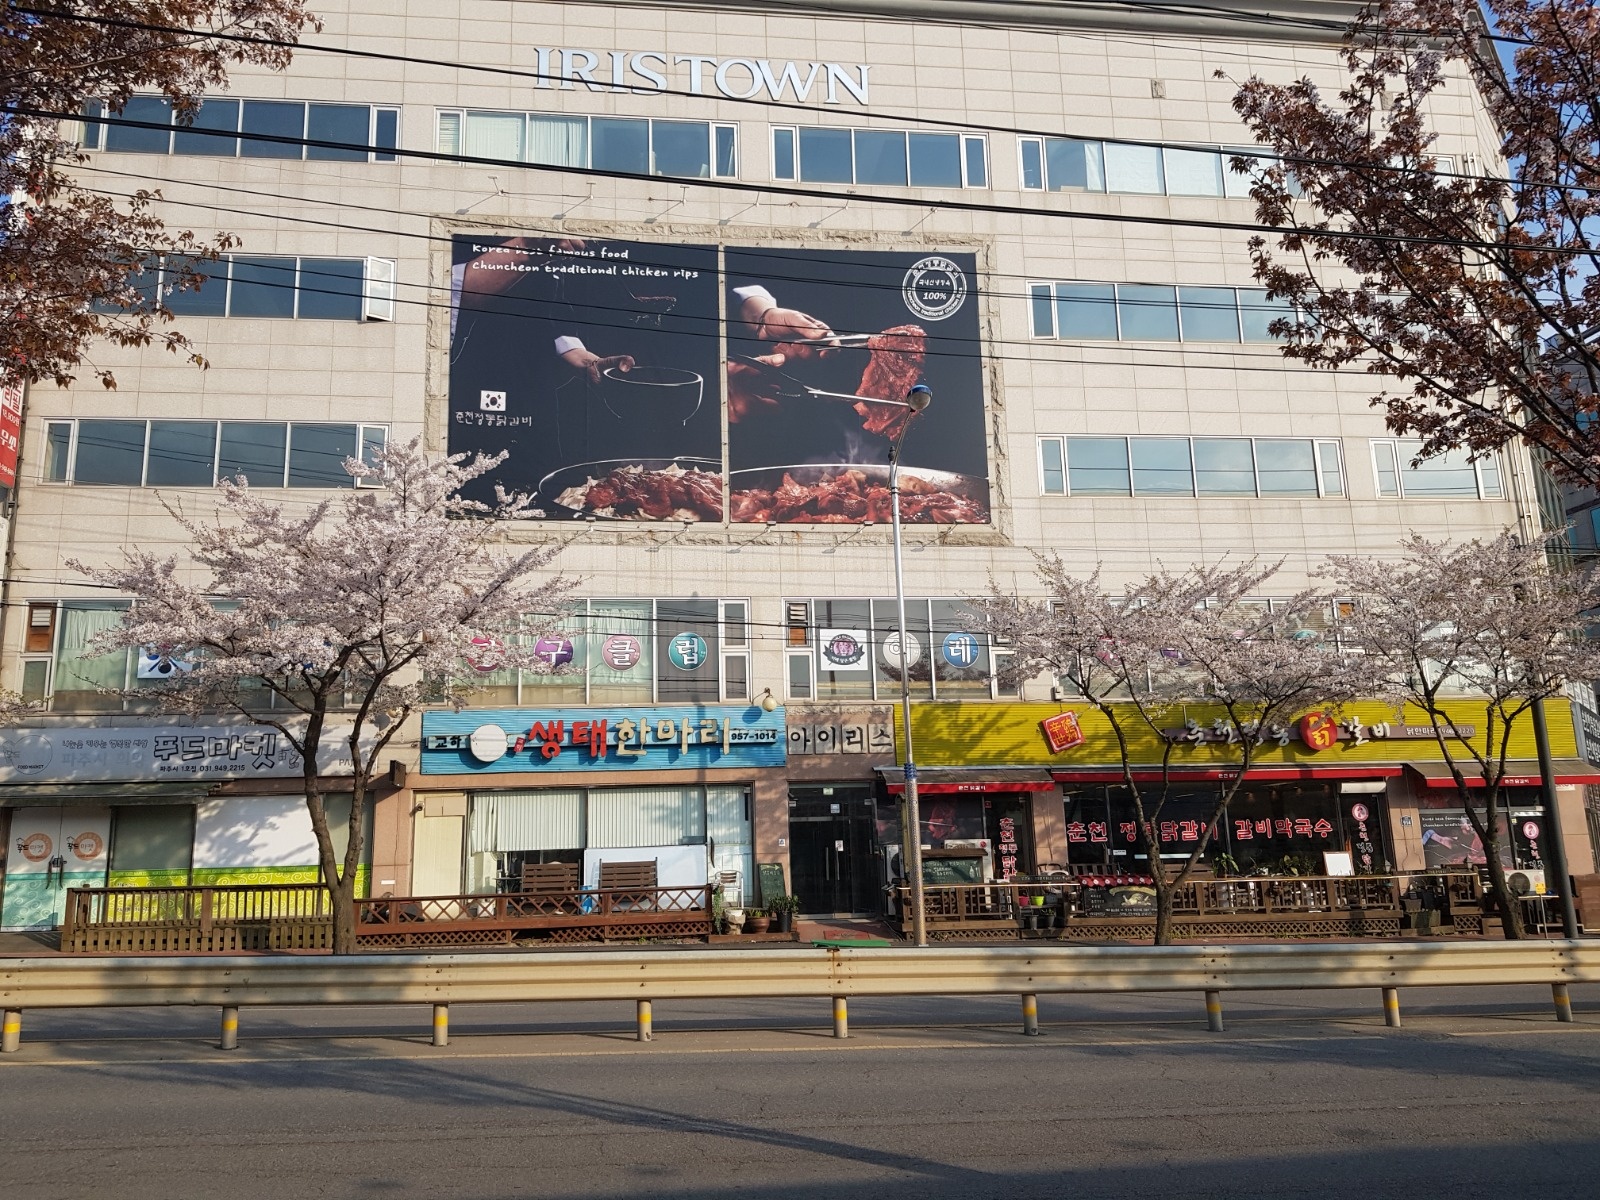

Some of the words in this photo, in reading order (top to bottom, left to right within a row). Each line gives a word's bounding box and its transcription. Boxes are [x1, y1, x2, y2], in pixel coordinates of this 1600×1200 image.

[534, 48, 871, 105] IRISTOWN
[472, 244, 510, 253] Korea
[601, 247, 629, 259] food
[544, 264, 617, 276] traditional
[621, 267, 669, 277] chicken
[673, 270, 699, 280] rips
[923, 292, 947, 300] 100%
[731, 731, 777, 741] 957-1014
[790, 726, 893, 752] 아이리스
[154, 734, 277, 770] 푸드마켓
[1067, 821, 1108, 842] 춘천
